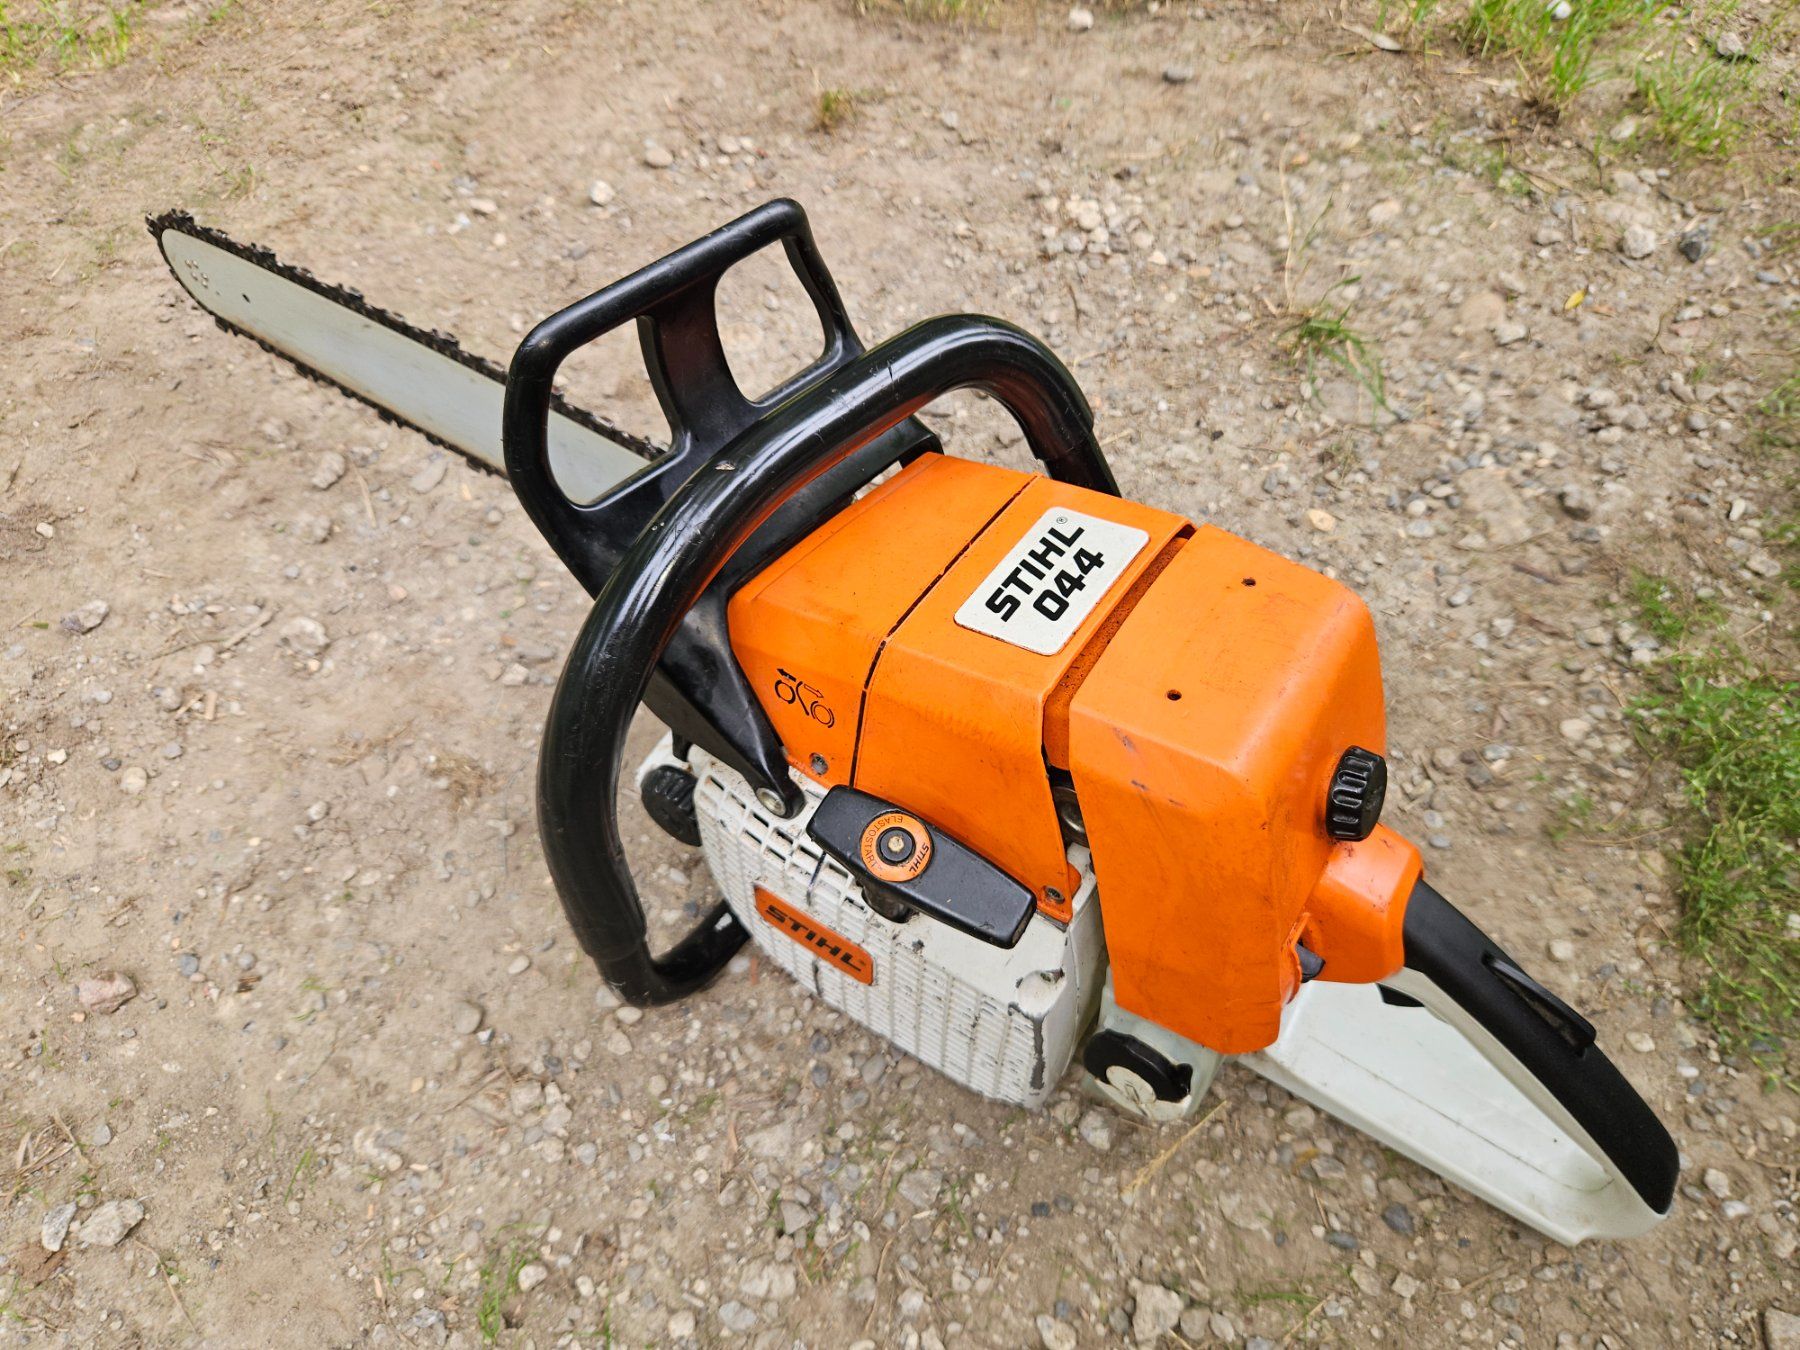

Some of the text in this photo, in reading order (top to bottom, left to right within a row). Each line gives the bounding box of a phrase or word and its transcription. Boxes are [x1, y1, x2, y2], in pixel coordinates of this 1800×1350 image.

[985, 526, 1085, 623] STIHL
[1032, 547, 1105, 622] 044
[864, 815, 904, 868] ELASTOSTART
[909, 842, 930, 873] STIHL
[765, 904, 862, 972] STIHL
